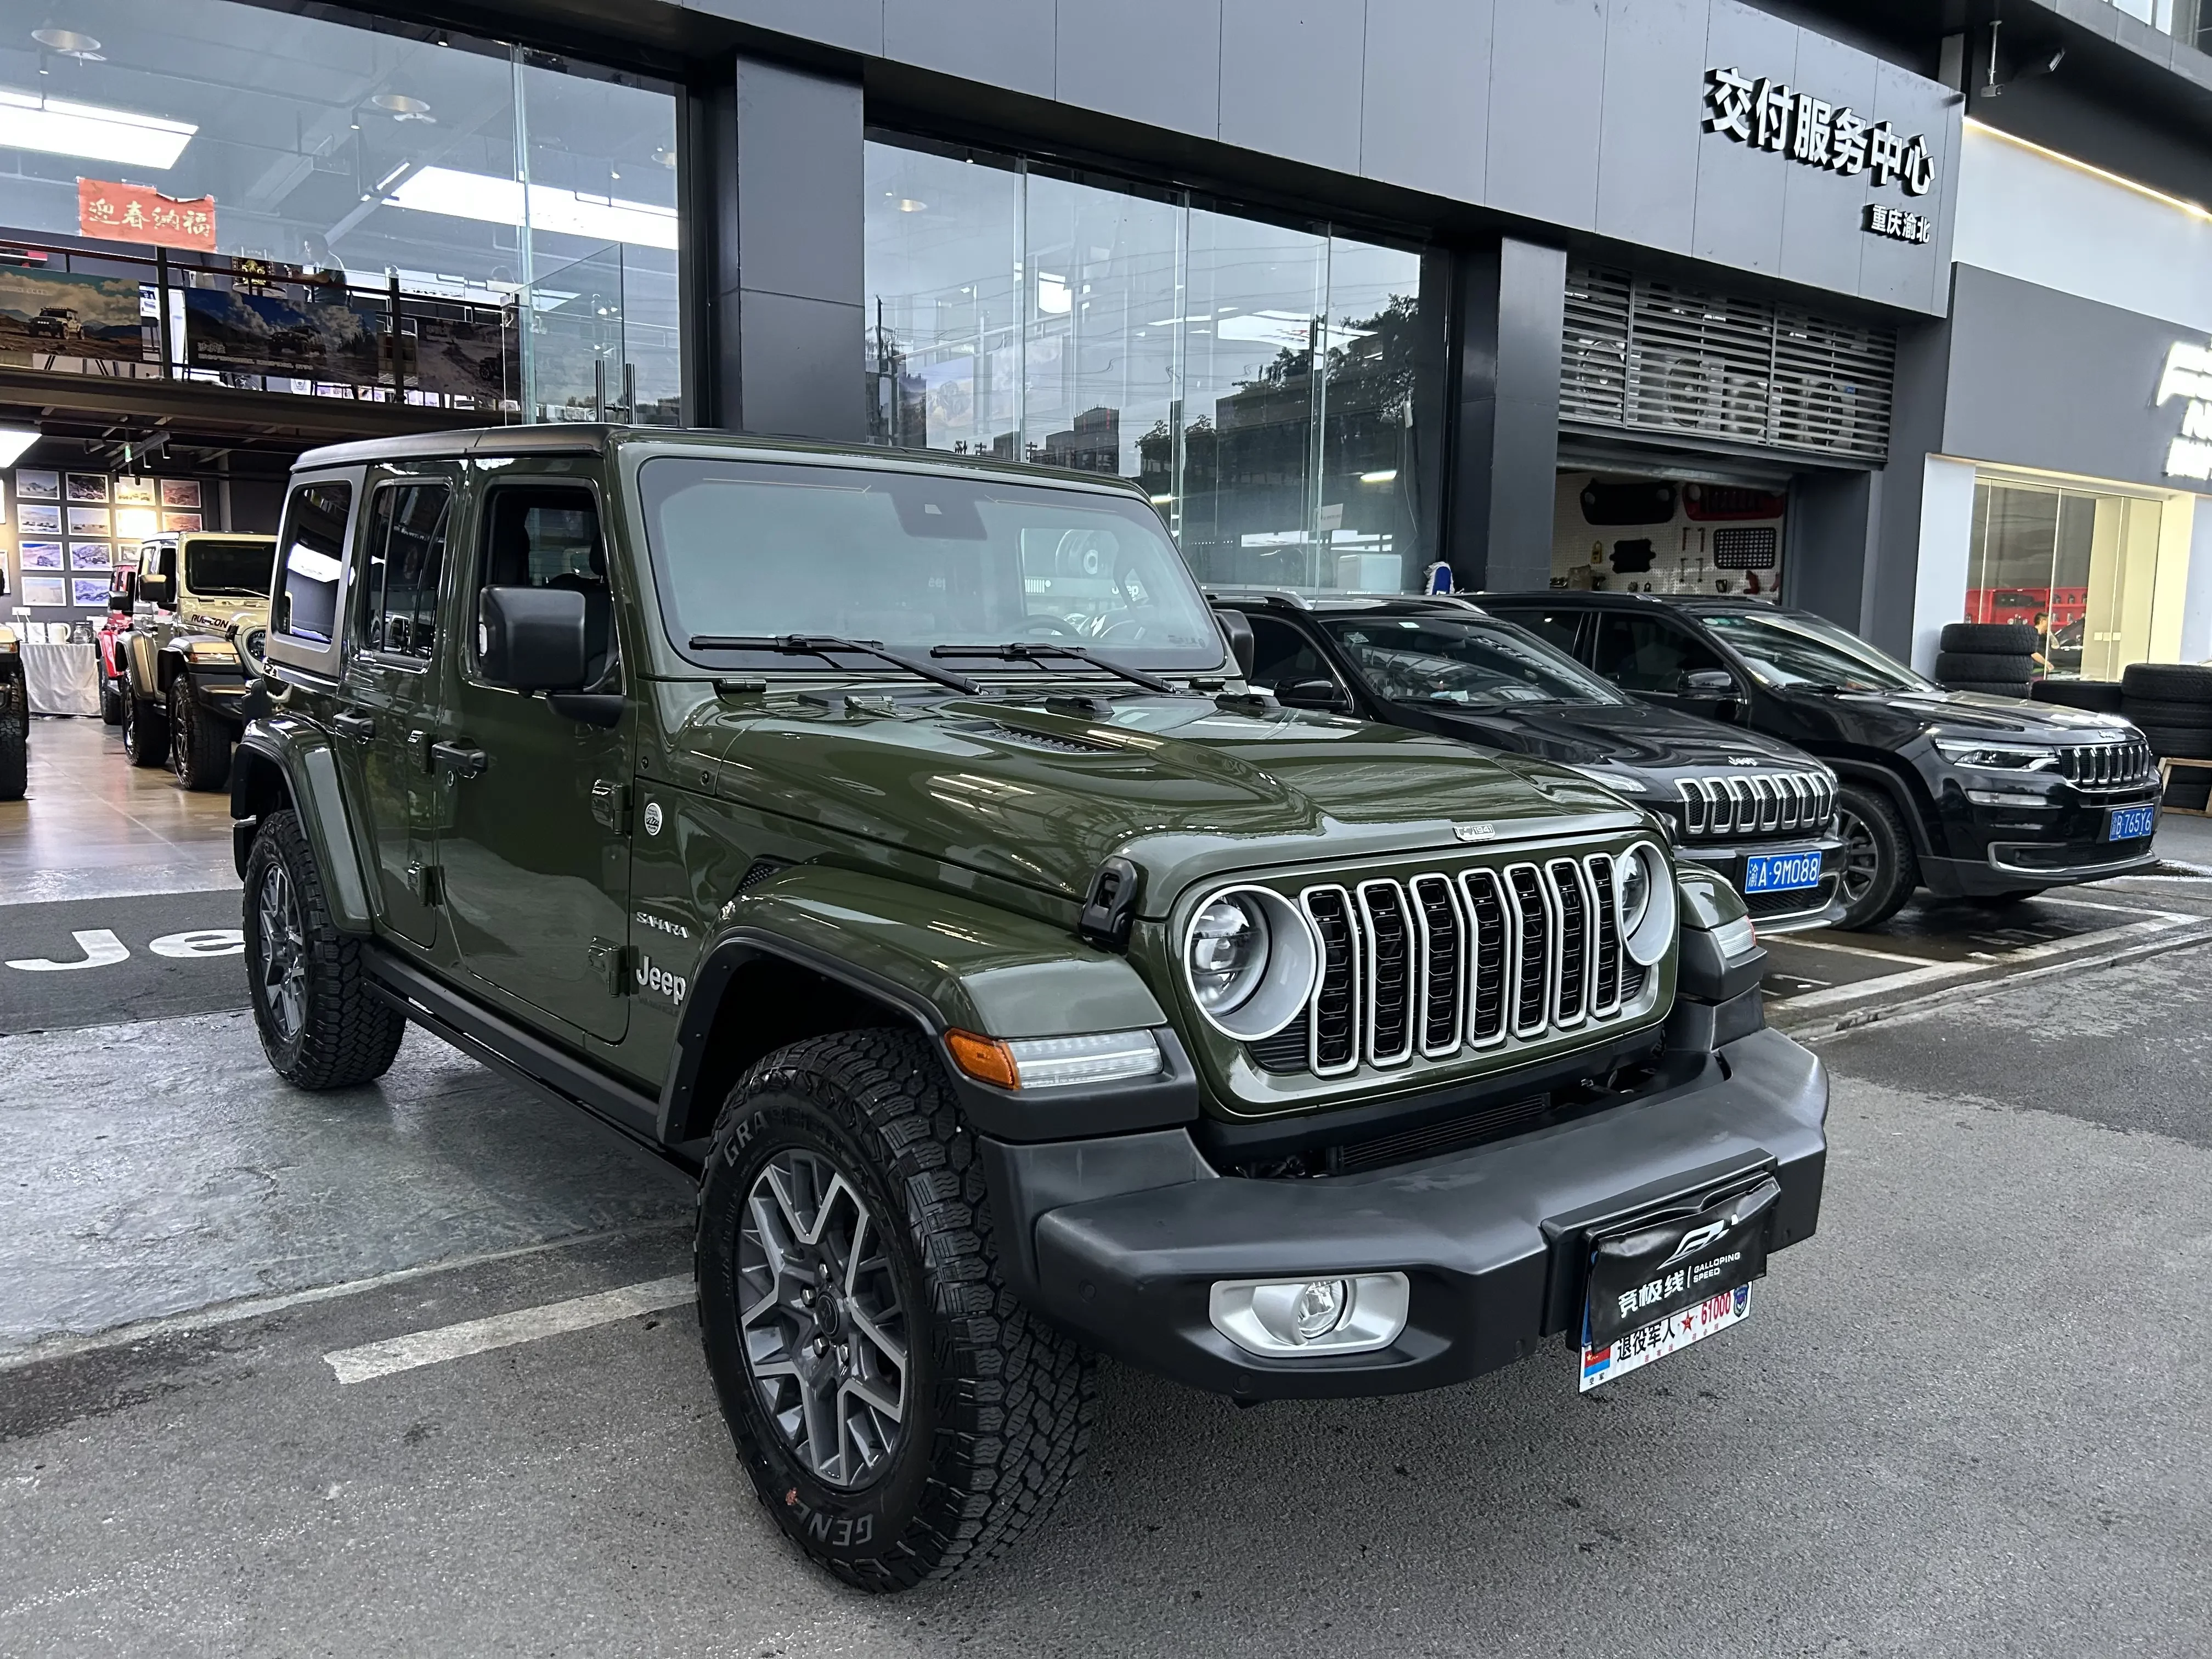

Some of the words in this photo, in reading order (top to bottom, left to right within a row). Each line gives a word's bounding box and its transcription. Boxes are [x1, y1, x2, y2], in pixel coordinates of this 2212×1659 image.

[1711, 66, 1937, 196] 交付服务中心
[88, 198, 211, 238] 迎春纳福
[1870, 204, 1932, 244] 重庆渝北
[1472, 825, 1493, 834] 1941
[636, 911, 690, 939] SAHARA
[635, 955, 686, 1006] Jeep
[1692, 1267, 1720, 1284] SPEED
[1693, 1251, 1741, 1274] GALLOPING
[1617, 1317, 1675, 1363] 退役军人
[1701, 1290, 1731, 1326] 61000
